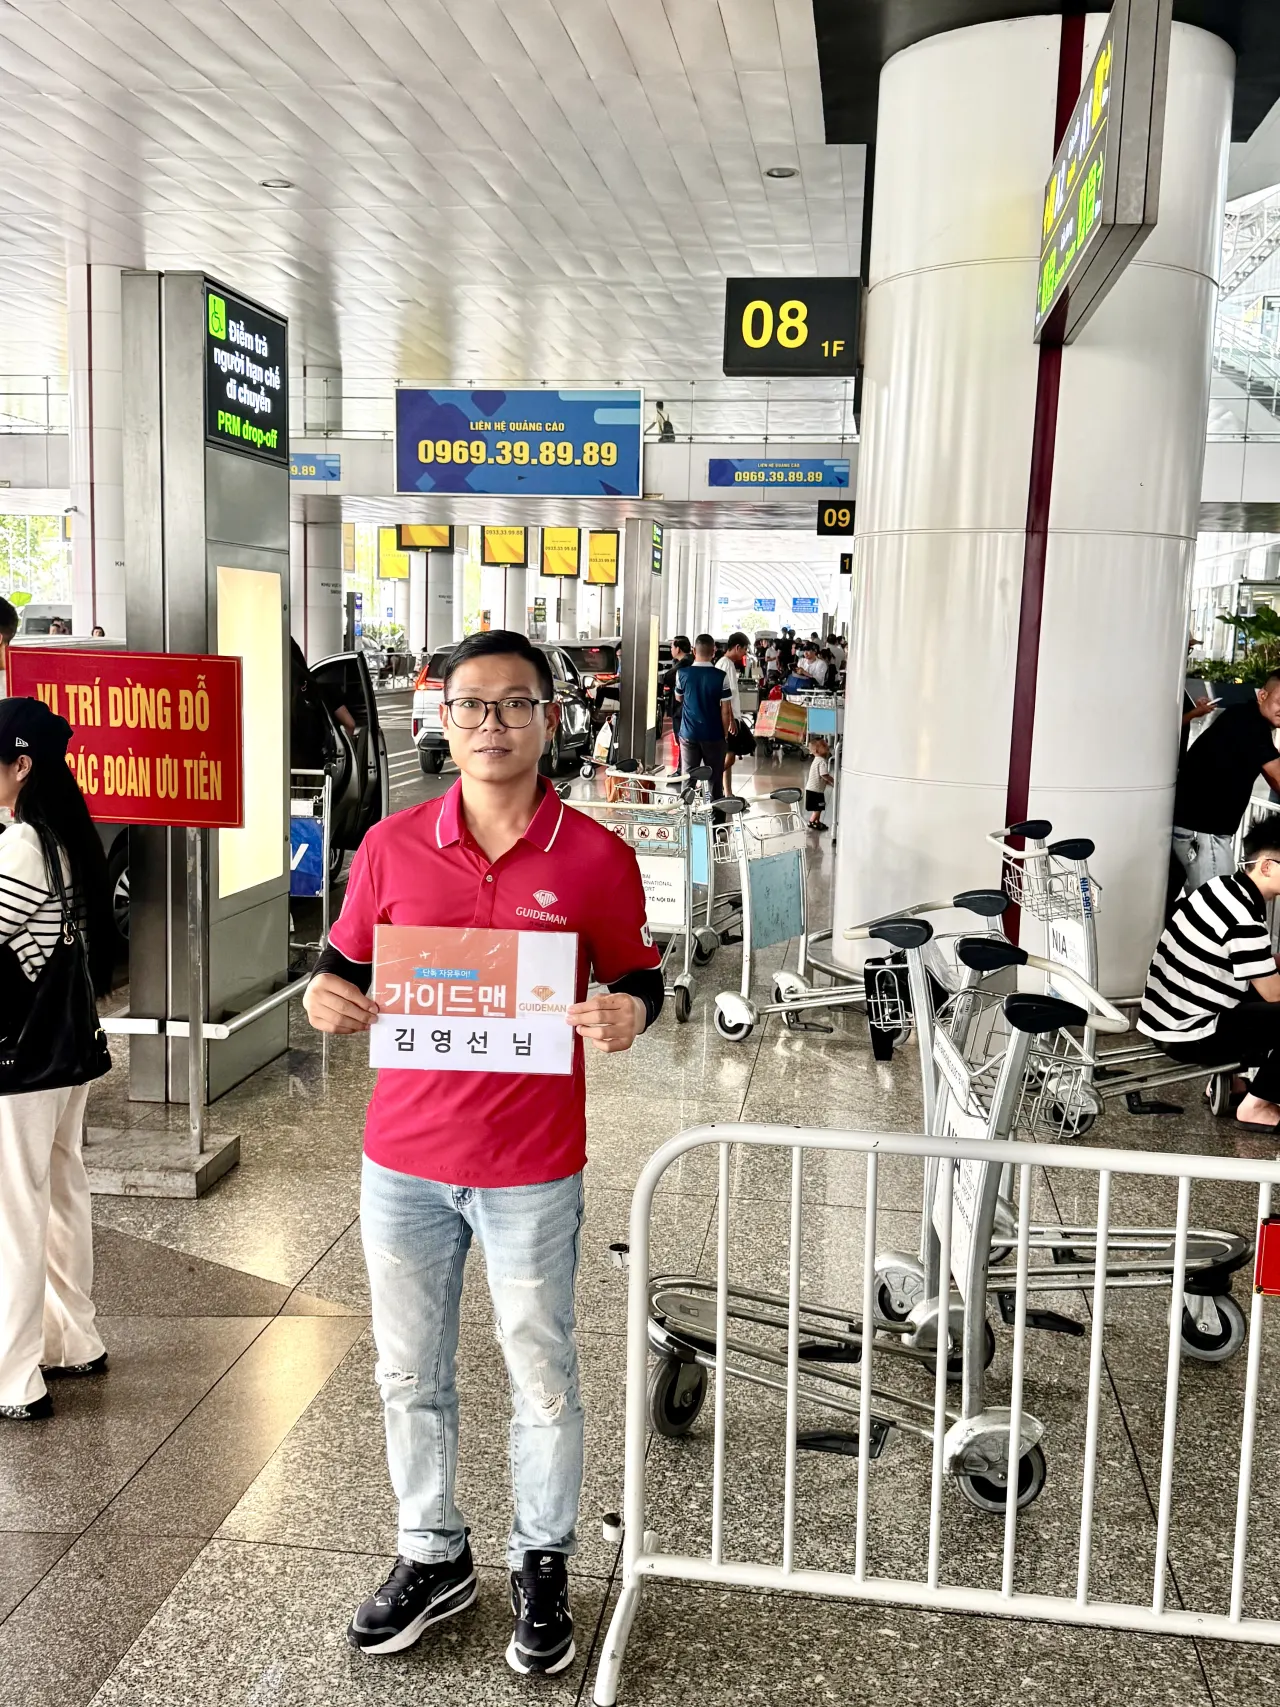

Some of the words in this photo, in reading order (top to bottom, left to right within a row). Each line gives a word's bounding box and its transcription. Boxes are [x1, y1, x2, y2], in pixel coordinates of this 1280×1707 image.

[742, 300, 809, 349] 08
[228, 319, 254, 351] Điểm
[254, 335, 268, 358] trả
[821, 340, 845, 358] 1F
[213, 346, 245, 375] người
[245, 356, 263, 384] hạn
[264, 365, 281, 390] chế
[226, 378, 237, 401] di
[237, 386, 272, 414] chuyển
[217, 409, 241, 438] PRM
[242, 419, 278, 449] drop-off
[469, 420, 492, 431] LIÊN
[494, 421, 507, 433] HỆ
[509, 419, 543, 432] QUẢNG
[545, 421, 565, 432] CÁO
[417, 439, 618, 466] 0969.39.89.89
[290, 465, 316, 475] 9.89
[734, 471, 823, 482] 0969.39.89.89
[823, 508, 851, 527] 09
[843, 558, 850, 570] 1
[65, 677, 101, 727] TRÍ
[108, 677, 171, 730] DỪNG
[178, 674, 210, 732] ĐỖ
[103, 747, 151, 797] ĐOÀN
[156, 753, 179, 799] ƯU
[183, 751, 222, 801] TIÊN
[515, 906, 568, 926] GUIDEMAN
[1051, 928, 1068, 958] NIA
[422, 968, 437, 978] 단독
[439, 969, 471, 979] 자유투어!
[384, 981, 507, 1017] 가이드맨
[518, 1002, 567, 1013] GUIDEMAN
